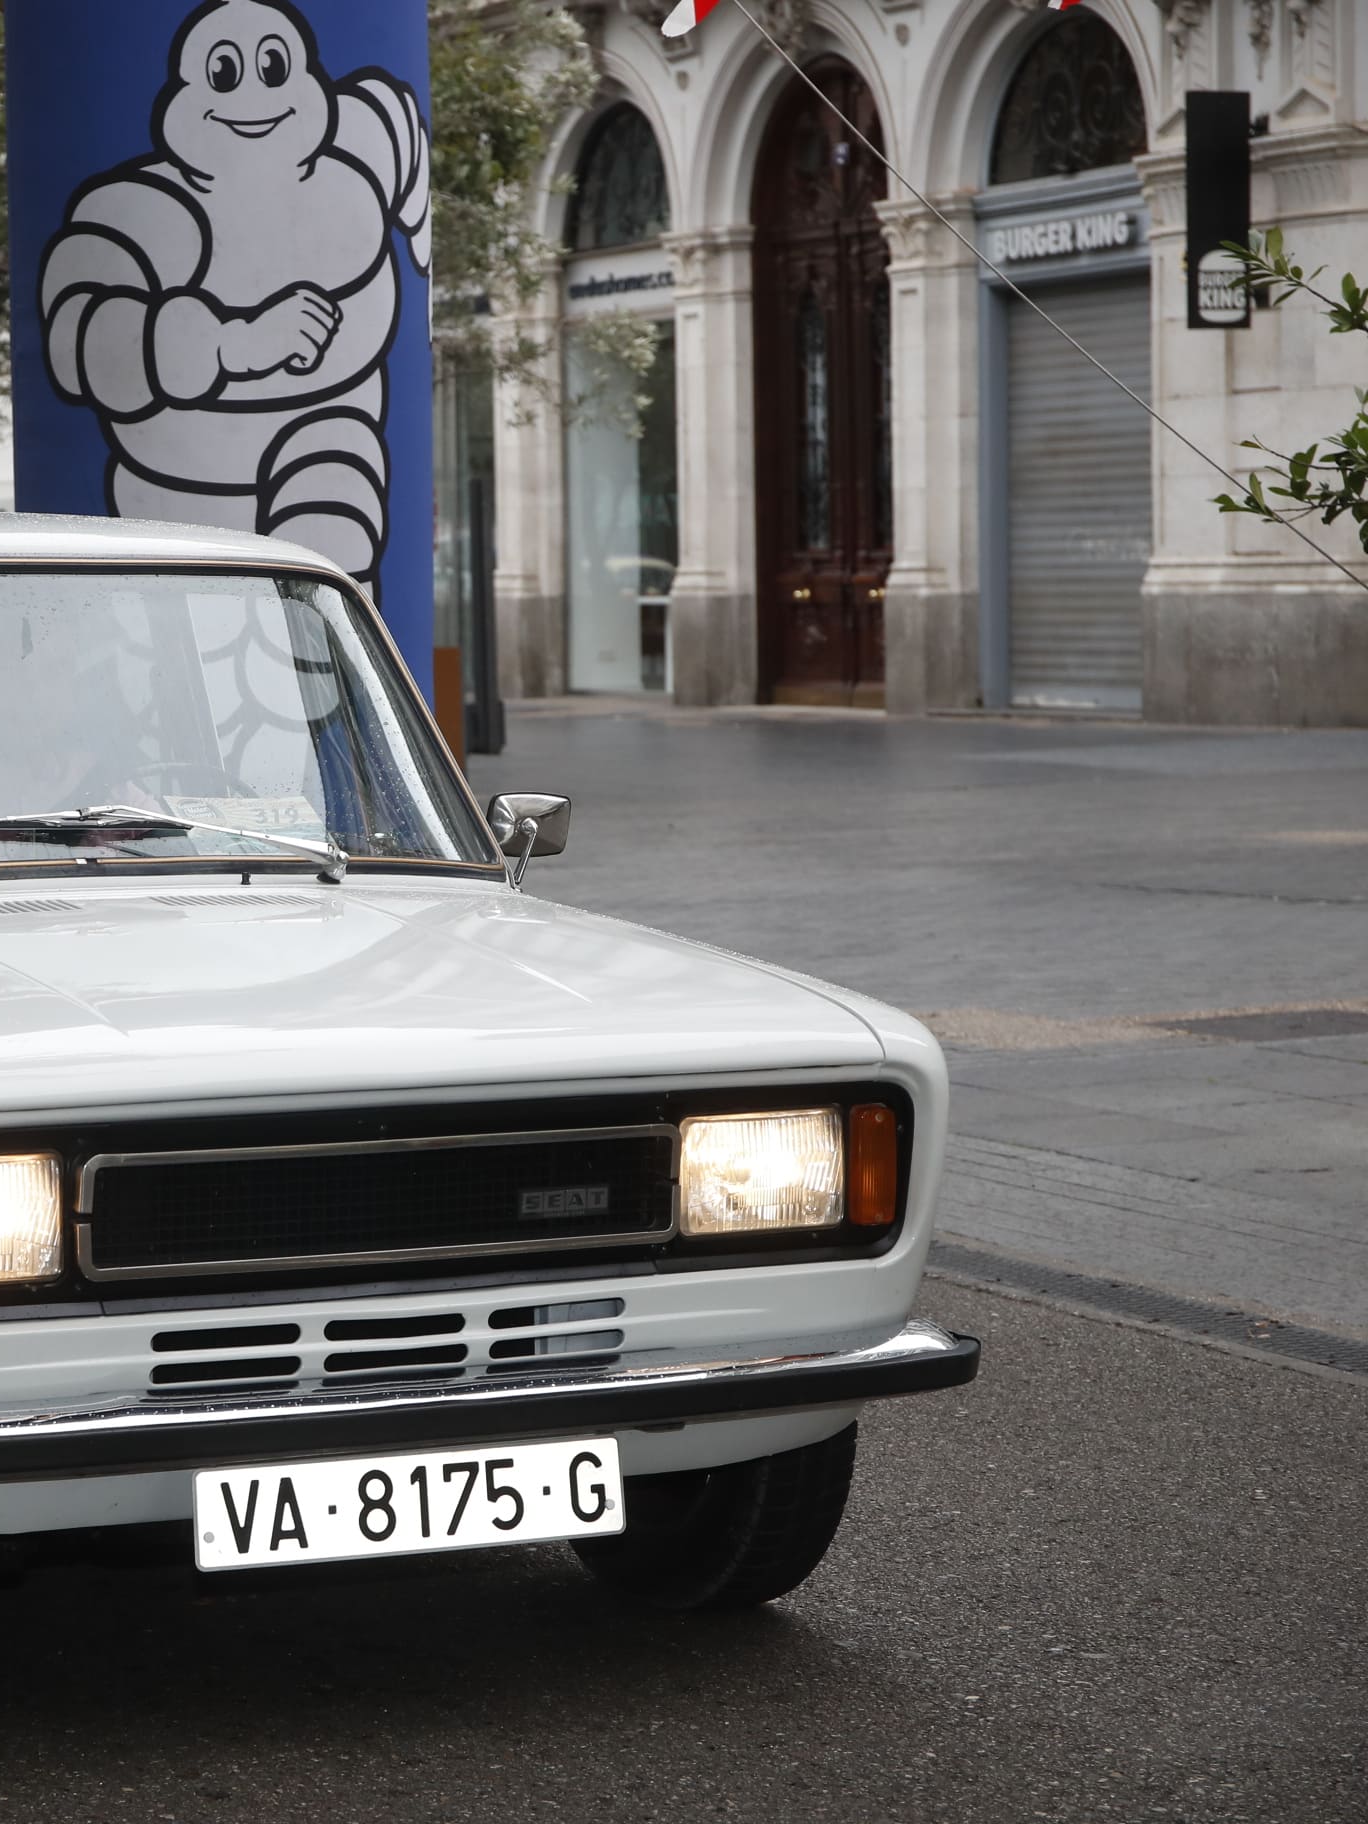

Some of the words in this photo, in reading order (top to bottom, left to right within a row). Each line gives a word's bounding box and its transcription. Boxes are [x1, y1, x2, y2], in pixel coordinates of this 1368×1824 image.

[993, 220, 1073, 262] BURGER
[1074, 211, 1129, 250] KING
[1199, 288, 1246, 308] KING
[255, 808, 298, 824] 319
[522, 1188, 608, 1212] SEAT
